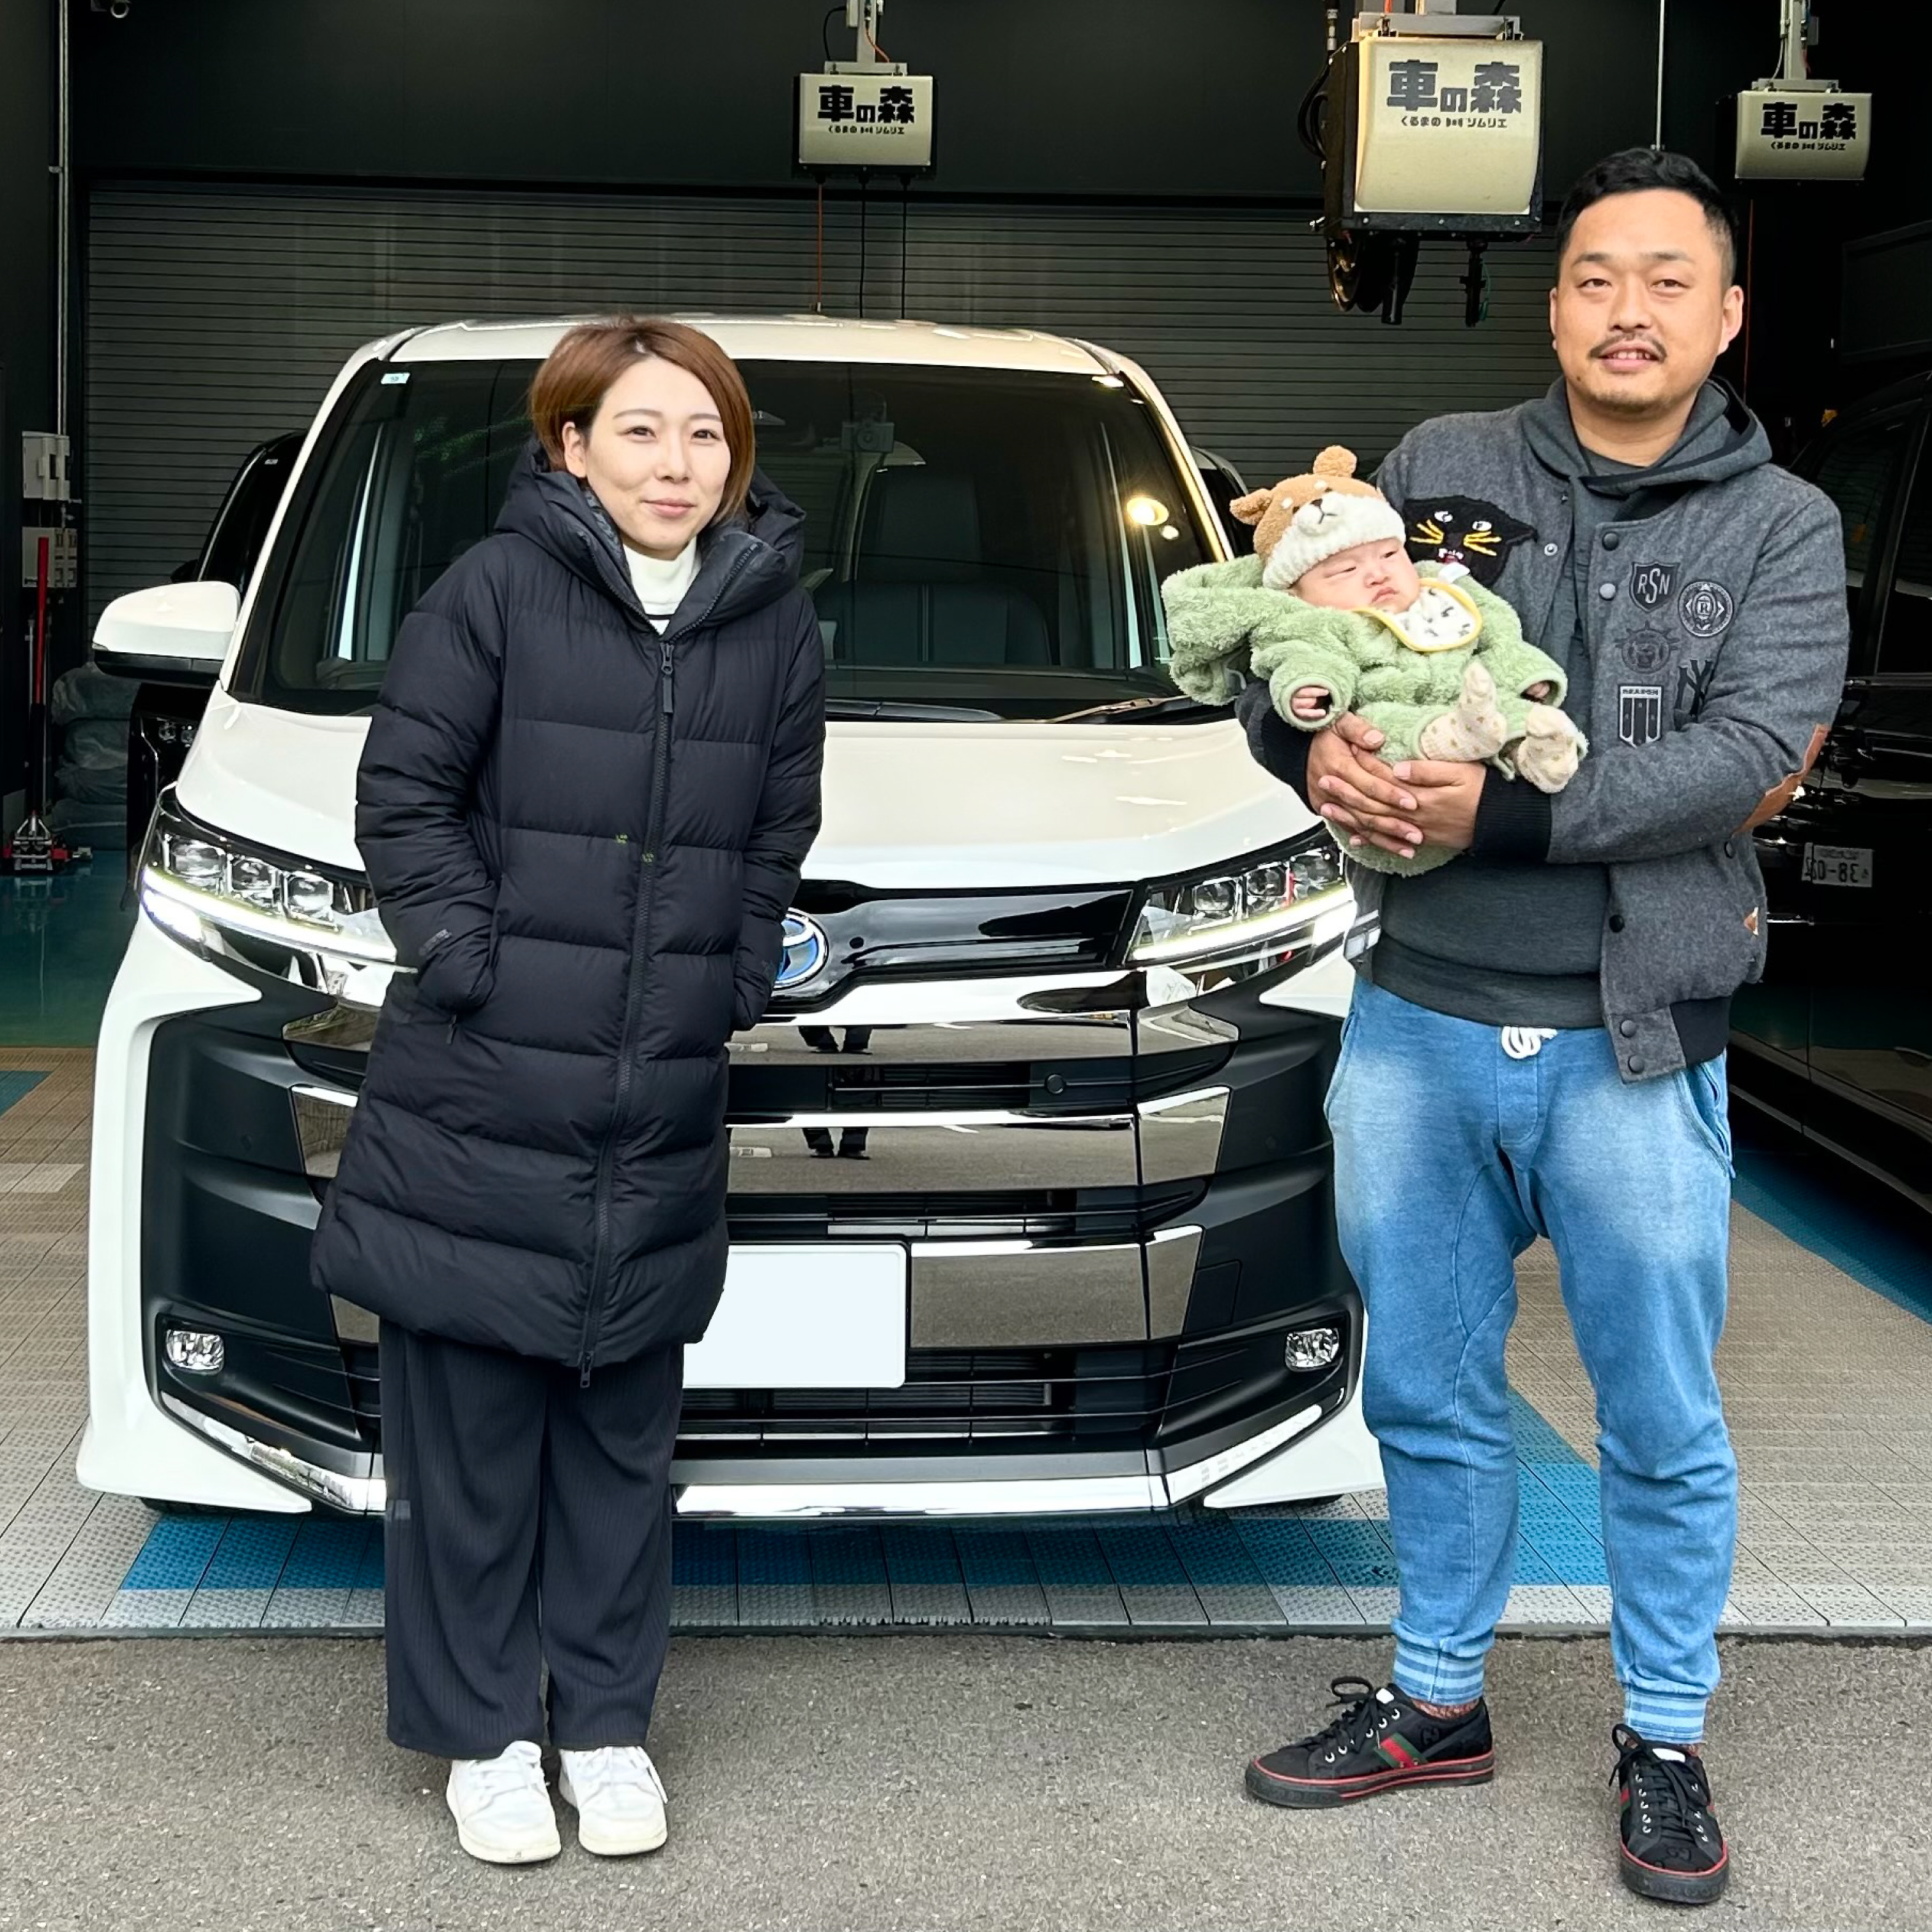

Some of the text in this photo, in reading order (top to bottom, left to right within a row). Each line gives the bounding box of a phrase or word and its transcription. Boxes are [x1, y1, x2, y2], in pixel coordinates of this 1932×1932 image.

[818, 85, 915, 123] 車の森
[1386, 59, 1522, 113] 車の森
[1401, 116, 1507, 128] くるまの ソムリエ
[1761, 102, 1857, 140] 車の森
[1637, 568, 1671, 604] RSN
